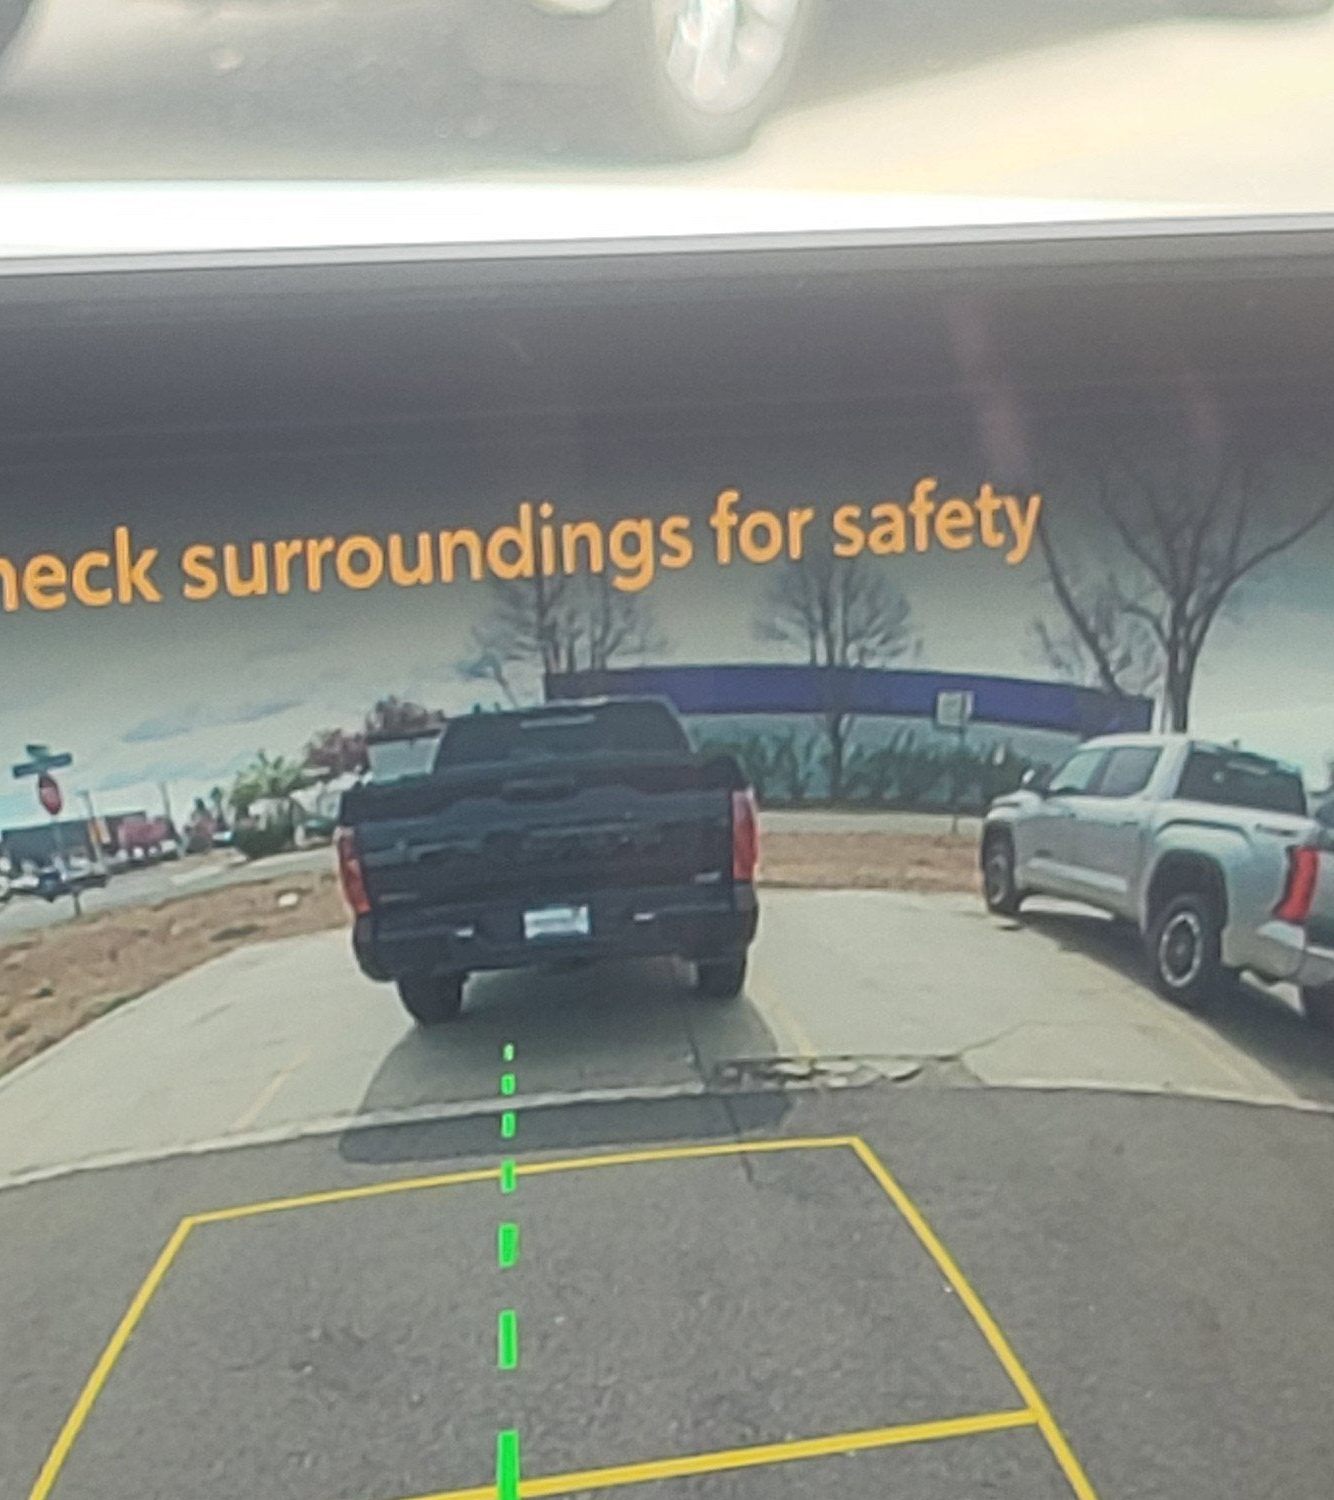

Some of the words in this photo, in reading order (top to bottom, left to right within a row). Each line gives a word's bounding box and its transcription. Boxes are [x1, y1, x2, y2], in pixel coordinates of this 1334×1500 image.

[180, 501, 694, 601] surroundings
[709, 488, 815, 566] for
[831, 476, 1042, 565] safety
